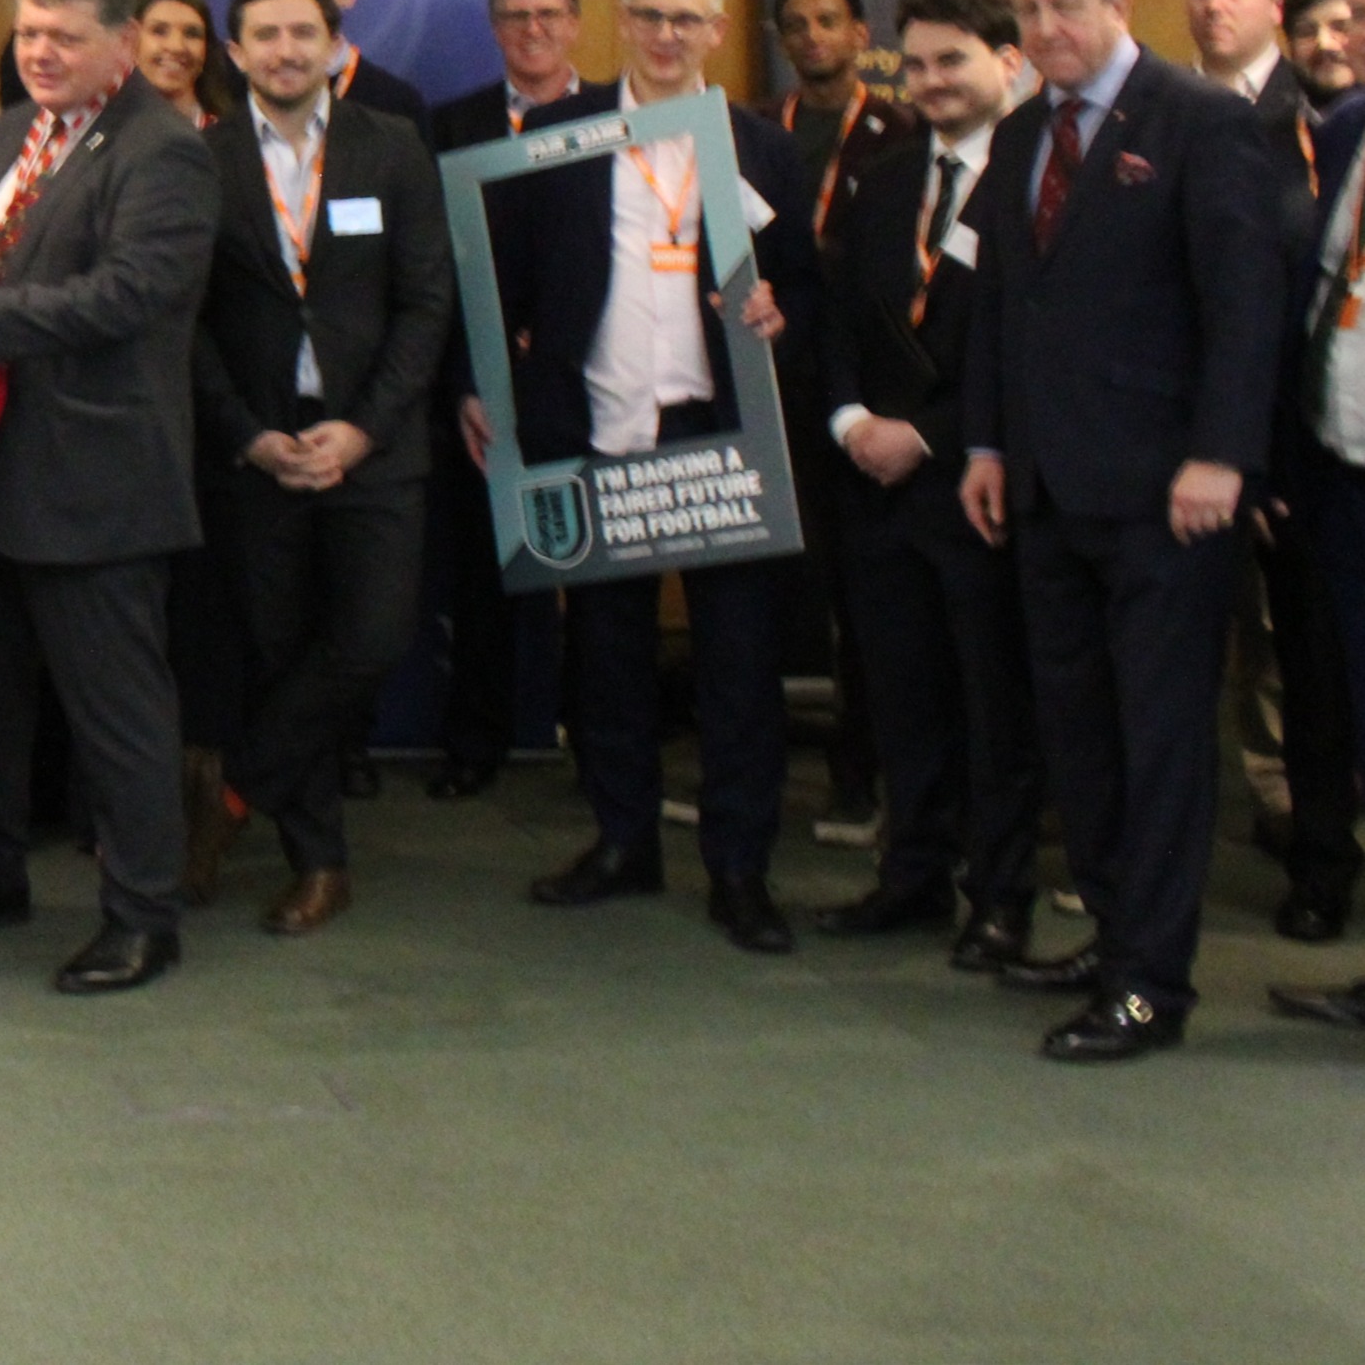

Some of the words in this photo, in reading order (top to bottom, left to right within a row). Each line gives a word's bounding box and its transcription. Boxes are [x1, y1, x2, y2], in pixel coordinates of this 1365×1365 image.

[626, 448, 723, 488] BACKING
[724, 443, 745, 472] A
[597, 484, 675, 520] FAIRER
[675, 469, 763, 508] FUTURE
[601, 514, 648, 547] FOR
[646, 496, 763, 540] FOOTBALL
